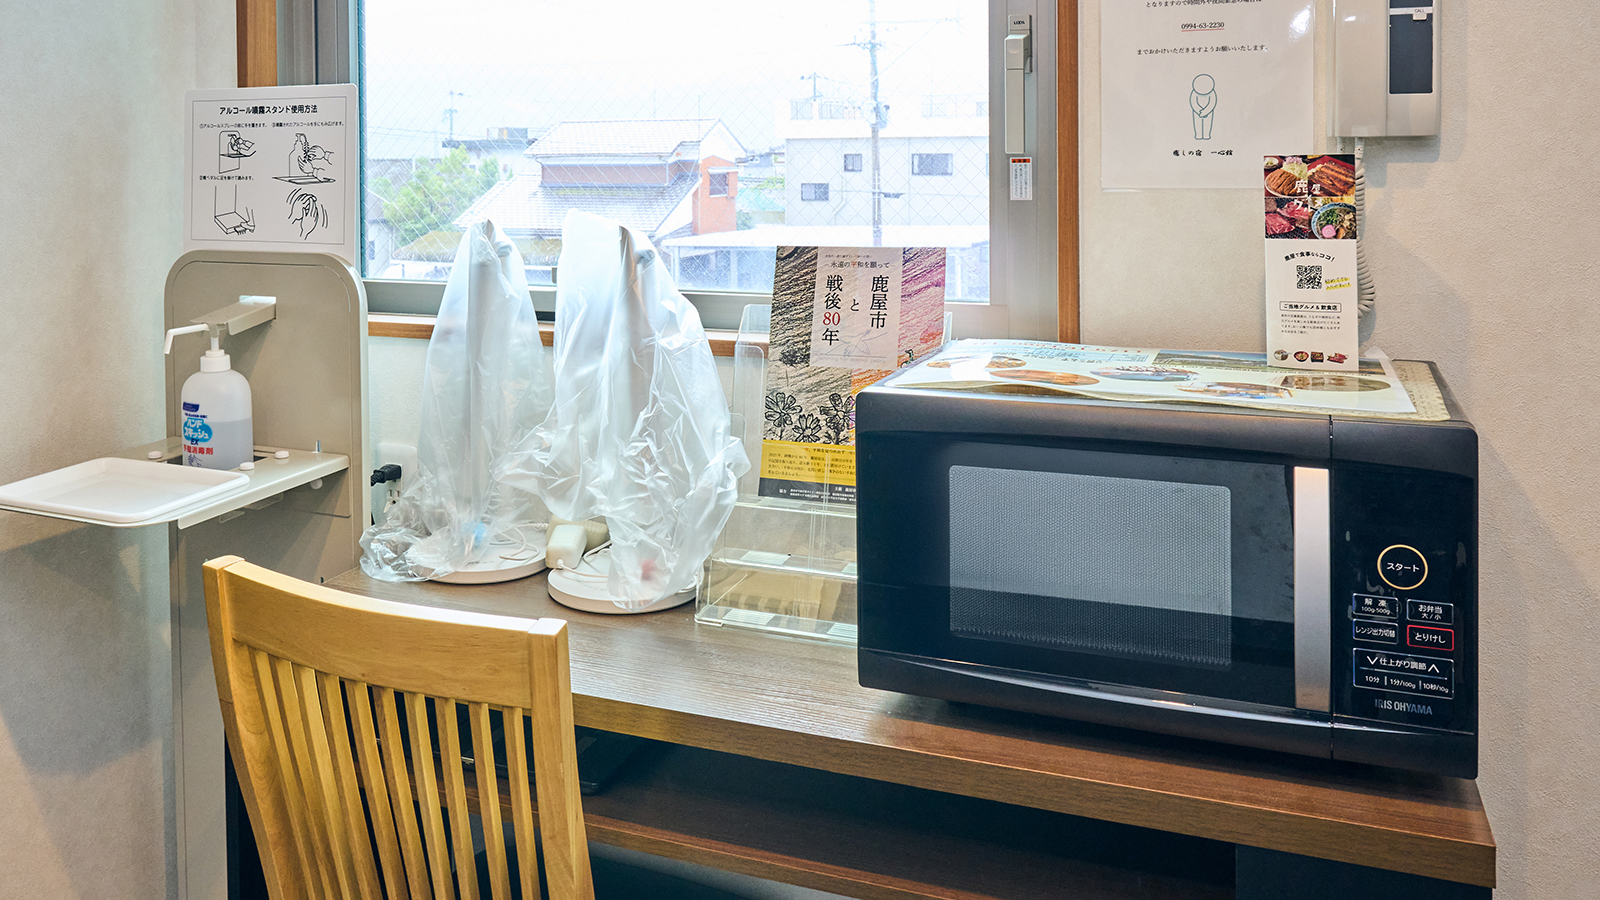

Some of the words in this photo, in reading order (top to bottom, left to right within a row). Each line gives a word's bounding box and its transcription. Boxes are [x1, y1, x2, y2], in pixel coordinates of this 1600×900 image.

[219, 104, 318, 115] アルコール噴霧スタンド使用方法
[850, 299, 860, 312] と
[869, 275, 889, 329] 鹿屋市
[821, 275, 843, 346] 戦後80年
[187, 419, 203, 428] ハンド
[1387, 563, 1420, 572] スタート
[1418, 604, 1444, 615] お弁当
[1355, 626, 1396, 638] レンジ出力切替
[1414, 632, 1447, 644] とりけし
[1379, 657, 1428, 671] 仕上がり調節
[1374, 698, 1394, 711] IRIS
[1394, 701, 1433, 716] OHYAMA
